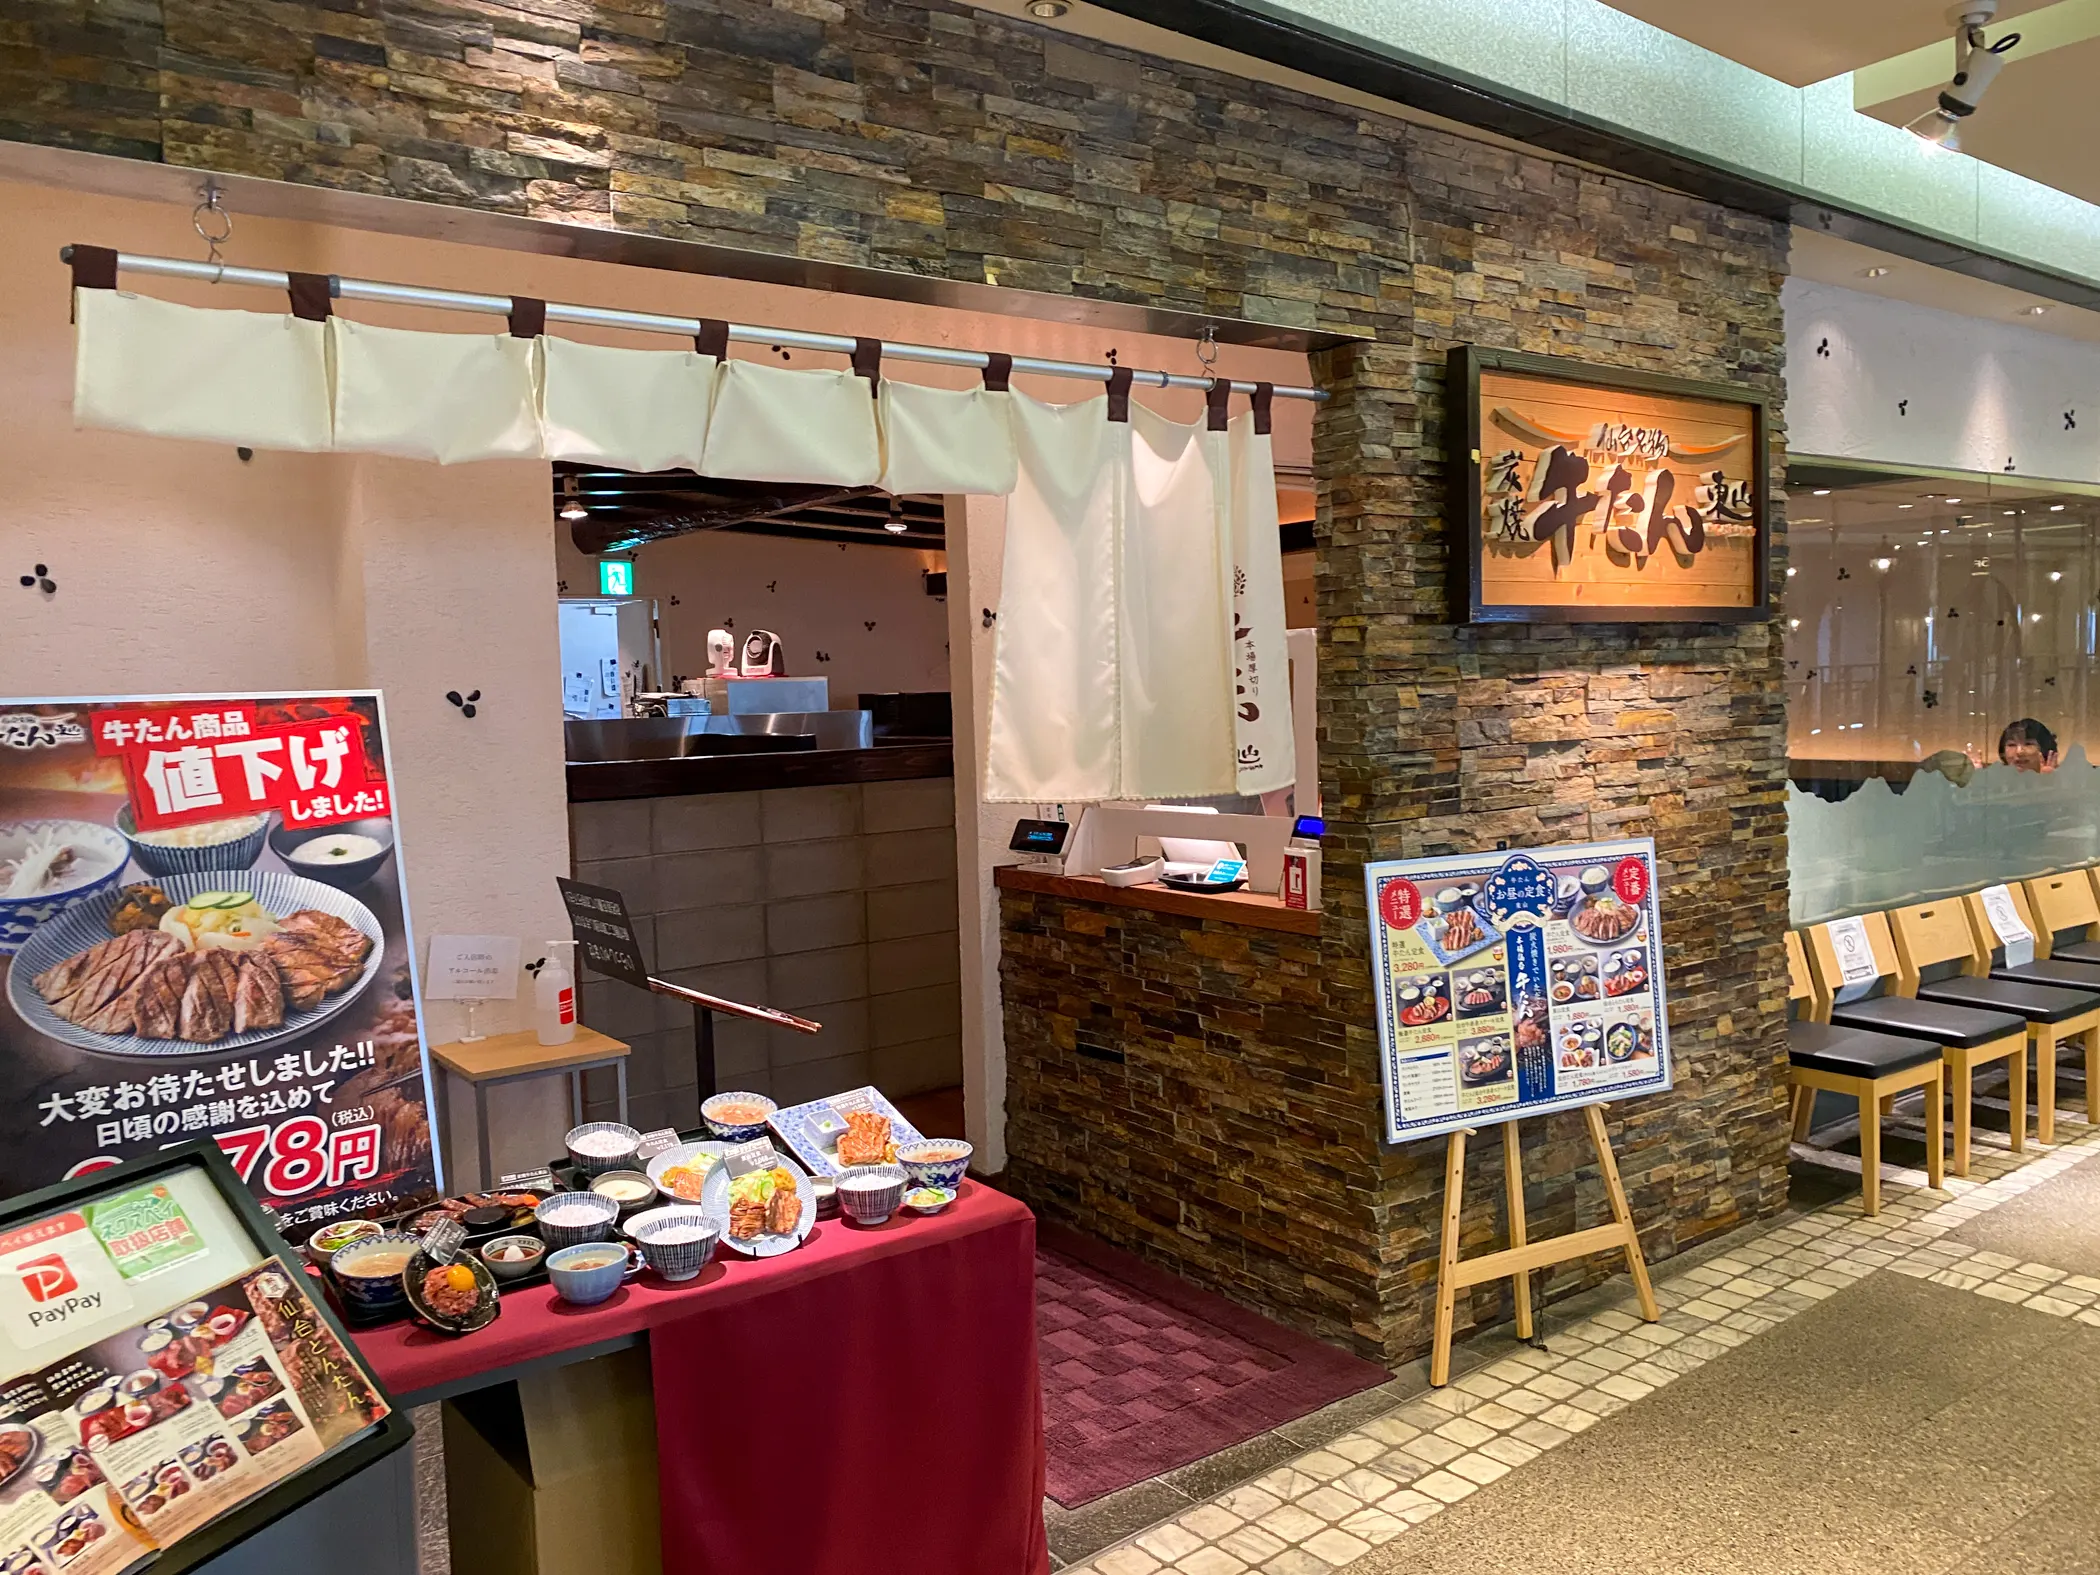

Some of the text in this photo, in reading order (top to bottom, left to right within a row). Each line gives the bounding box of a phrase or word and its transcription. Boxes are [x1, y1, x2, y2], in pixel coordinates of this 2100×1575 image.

[1596, 422, 1670, 458] 仙台名物
[1495, 449, 1531, 542] 炭焼
[1532, 444, 1705, 566] 牛たん
[0, 725, 56, 747] たん
[103, 710, 251, 747] 牛たん商品
[143, 726, 350, 816] 値下げ
[290, 788, 384, 822] しました!
[1496, 884, 1546, 900] お昼の定食
[38, 1039, 376, 1128] 大変お待たせしました!!
[96, 1079, 336, 1148] 日頃の感謝を込めて
[331, 1104, 375, 1127] (税込)
[28, 1290, 102, 1328] PayPay
[277, 1299, 367, 1409] 仙台とんたん
